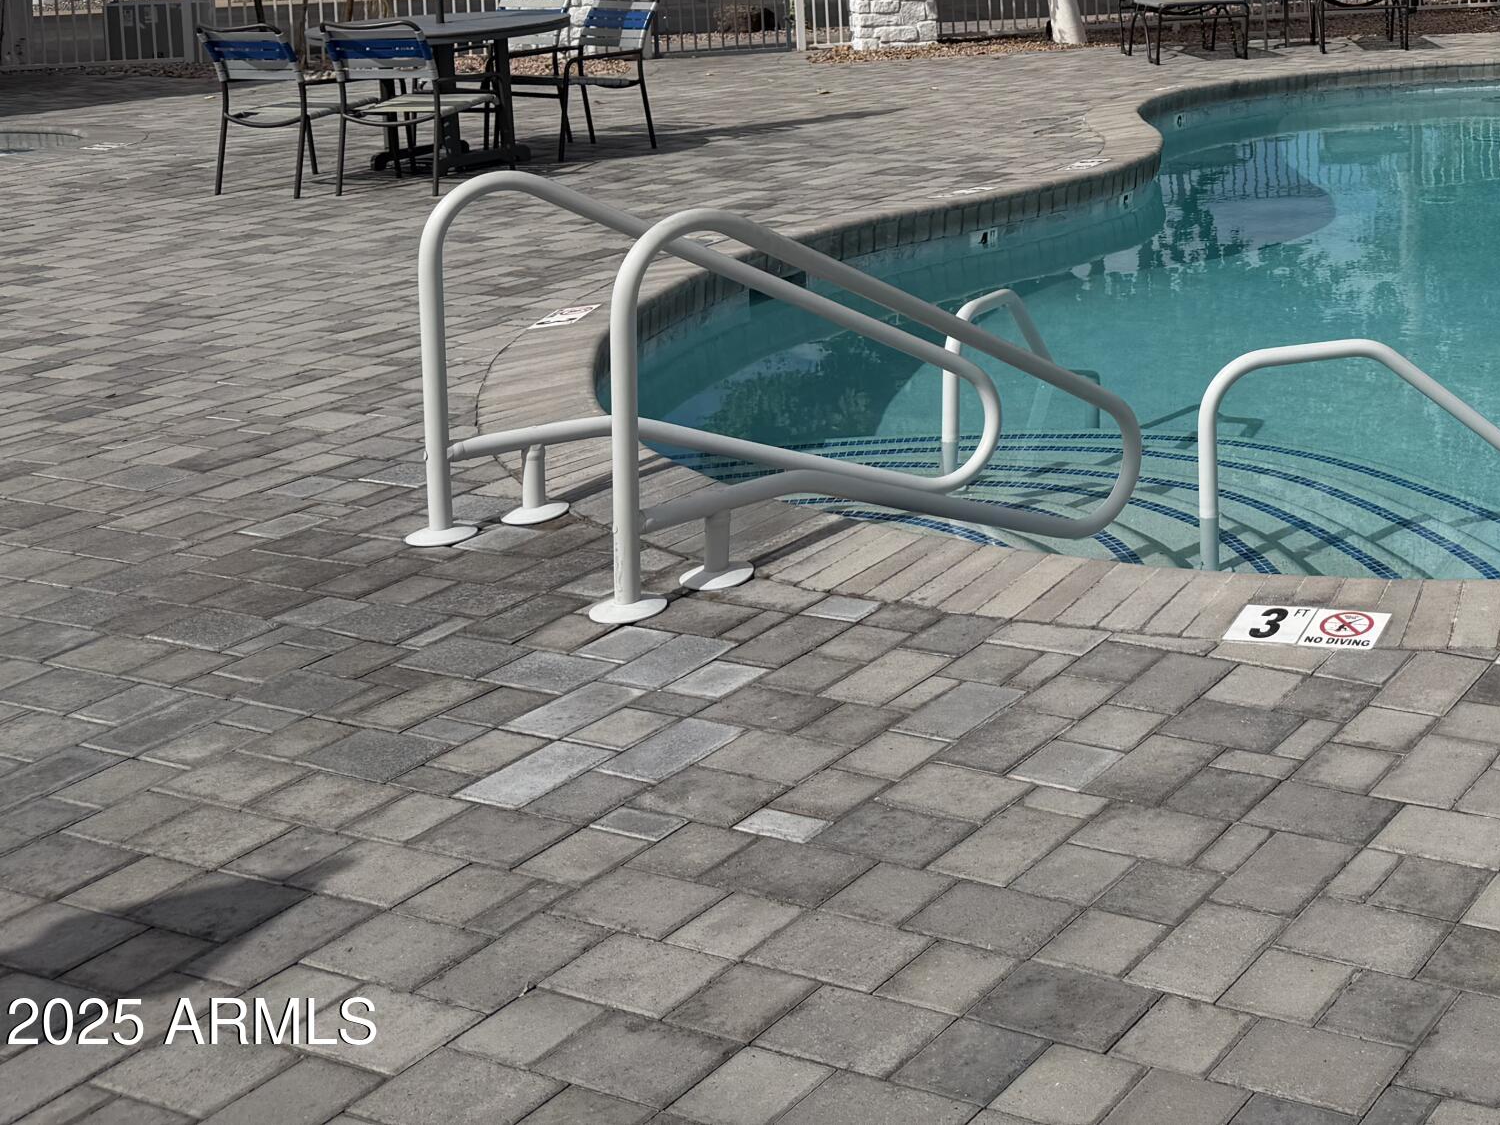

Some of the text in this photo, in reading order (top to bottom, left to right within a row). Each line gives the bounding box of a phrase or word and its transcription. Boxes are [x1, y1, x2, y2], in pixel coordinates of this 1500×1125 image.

[1248, 607, 1311, 639] 3 FT
[1304, 635, 1371, 648] NO DIVING
